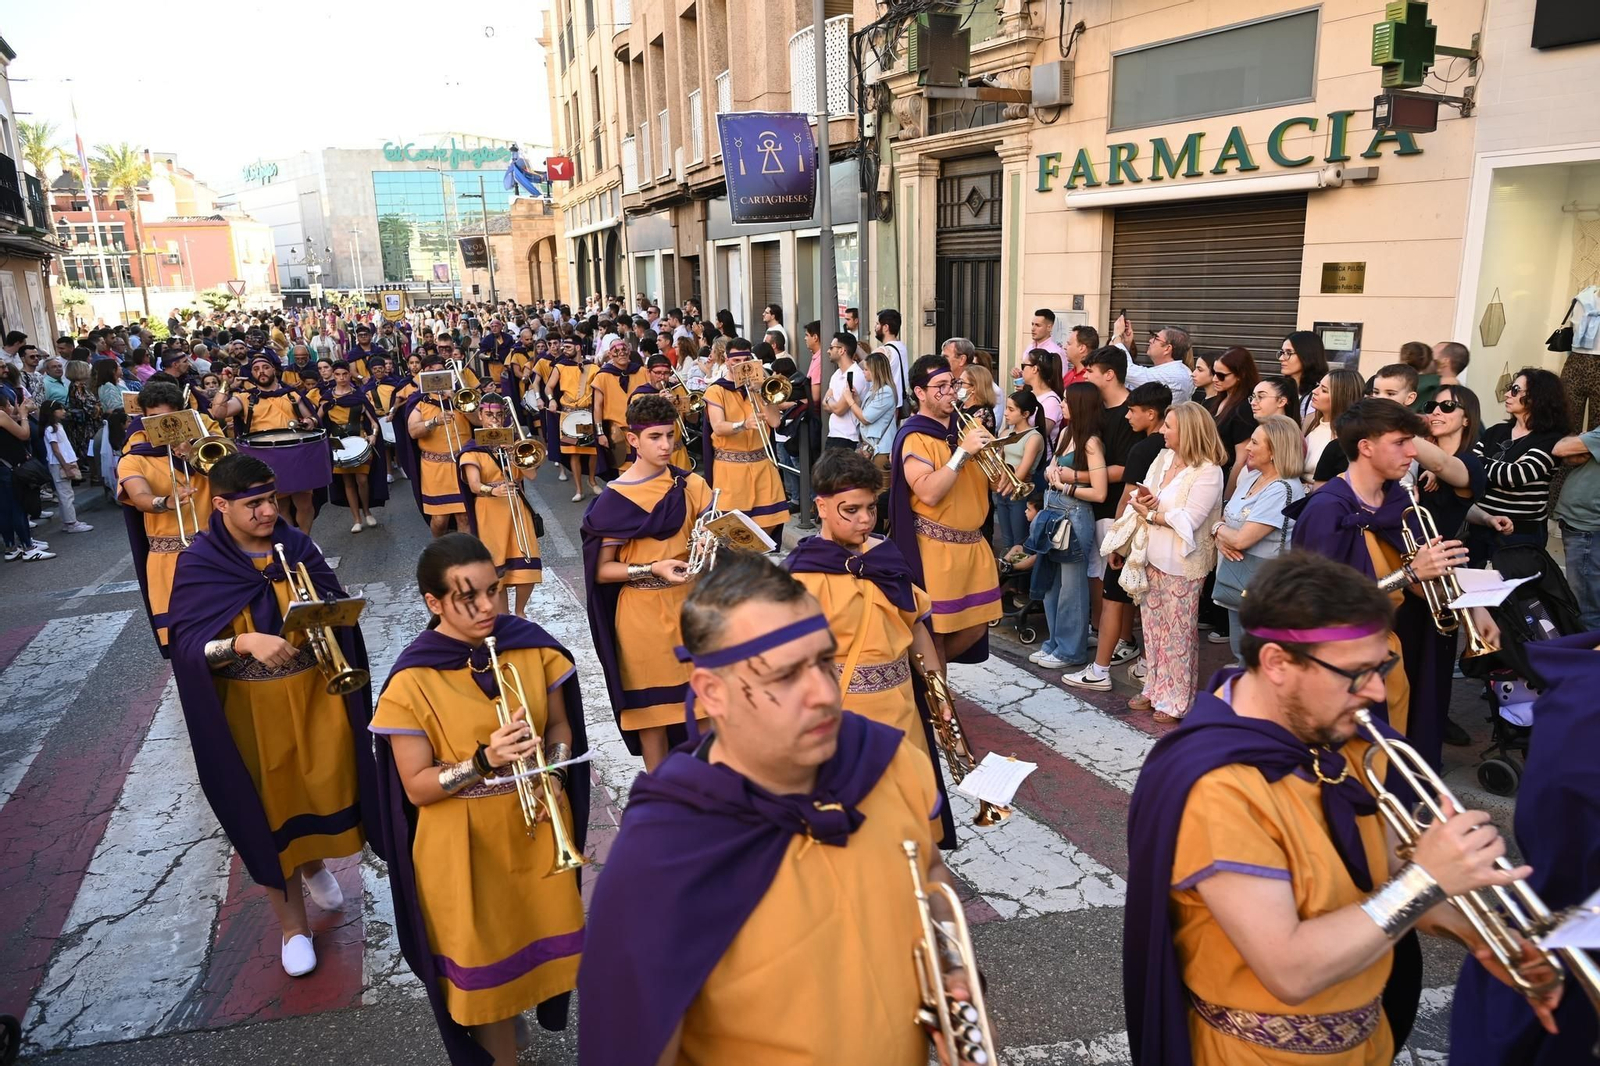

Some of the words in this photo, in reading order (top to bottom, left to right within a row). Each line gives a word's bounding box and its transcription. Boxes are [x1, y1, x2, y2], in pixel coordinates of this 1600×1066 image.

[383, 141, 404, 162] El
[404, 142, 449, 162] Corte
[1036, 111, 1424, 192] FARMACIA
[740, 194, 808, 205] CARTAGINESES
